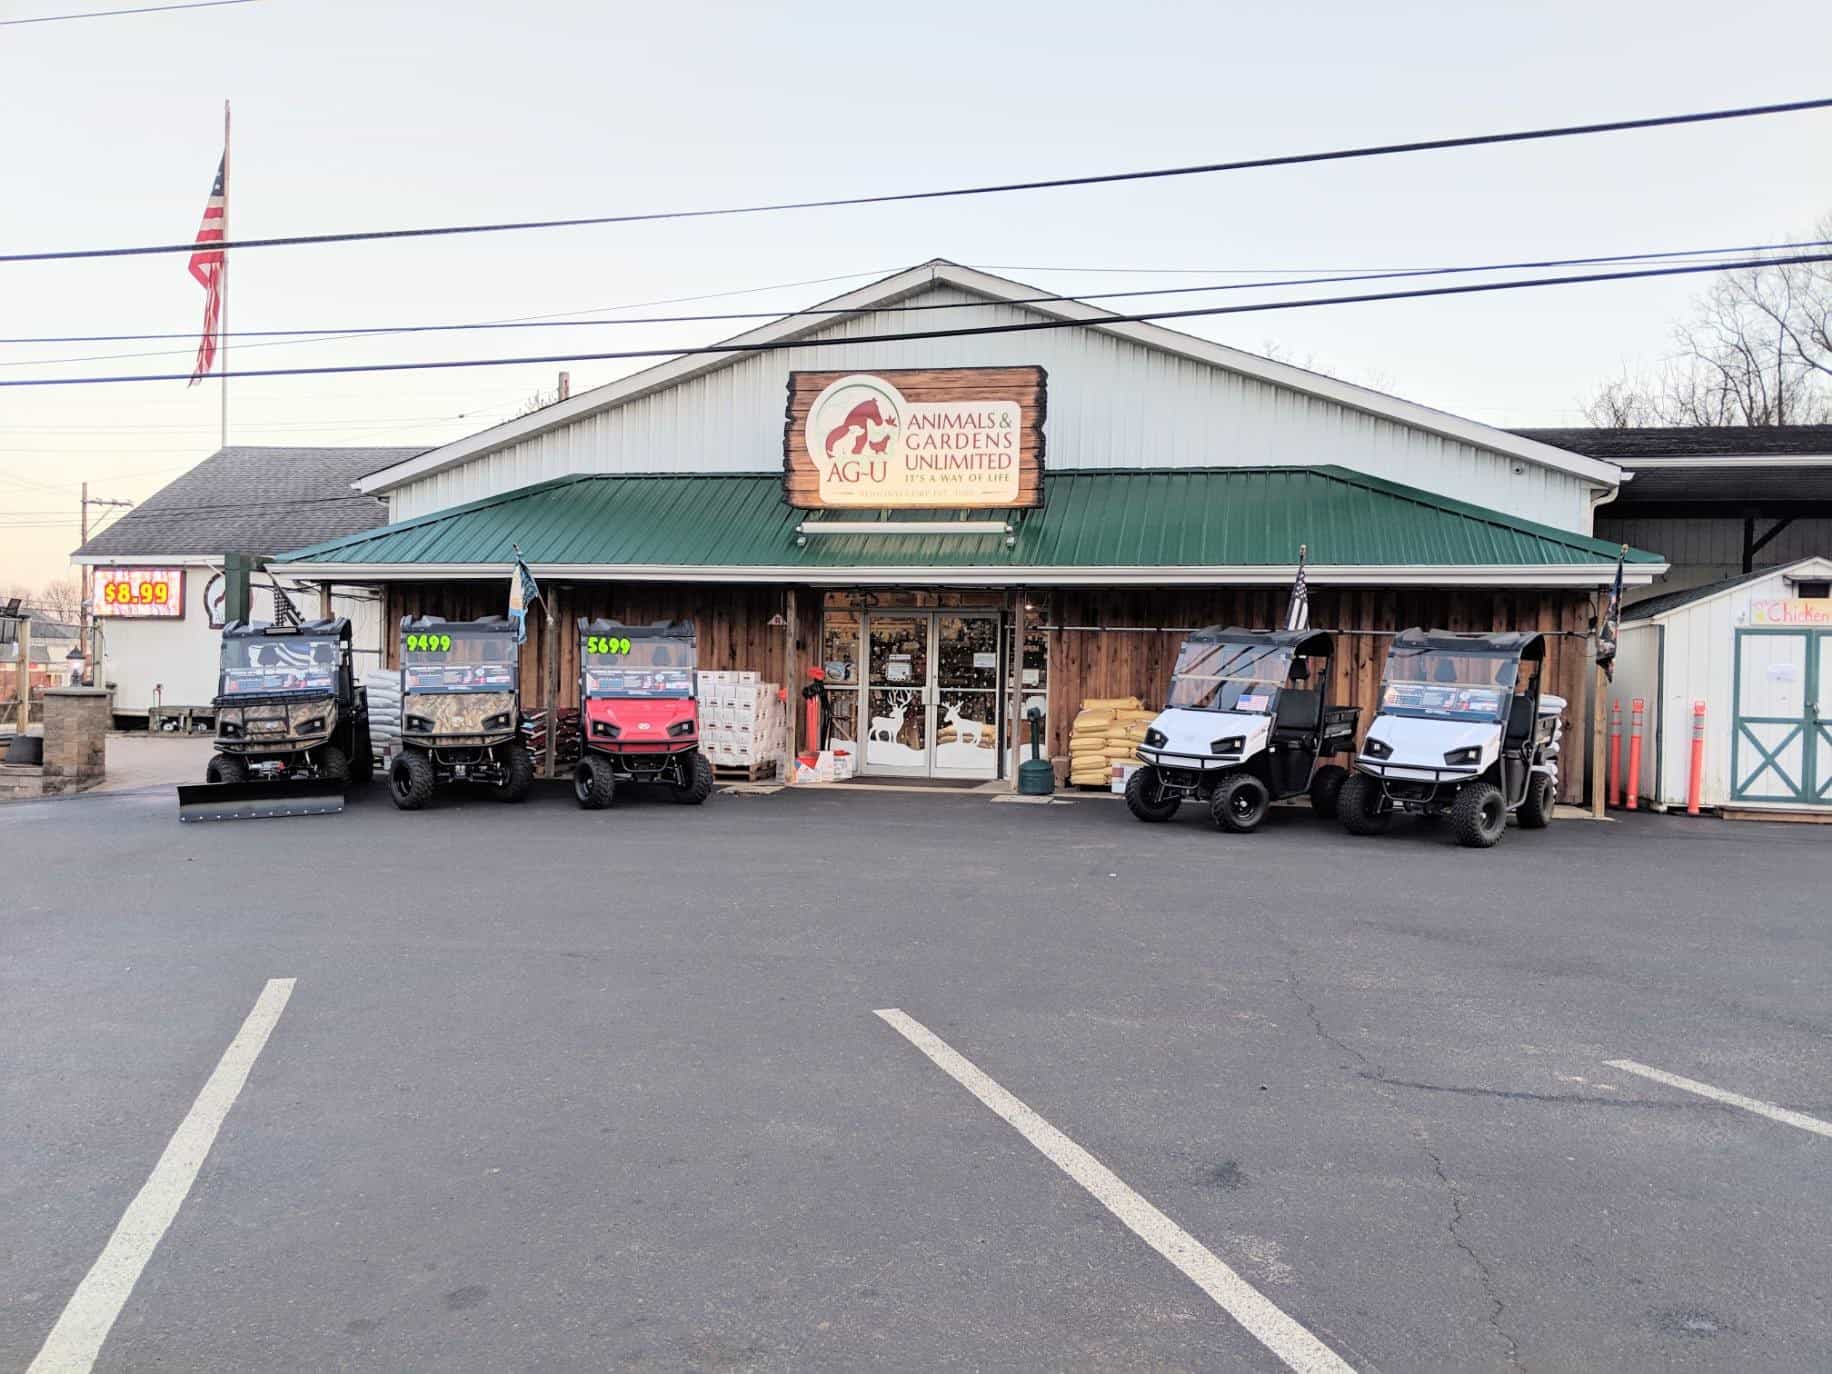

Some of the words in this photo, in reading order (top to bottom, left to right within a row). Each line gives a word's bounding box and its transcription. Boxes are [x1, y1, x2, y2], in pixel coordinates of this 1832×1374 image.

[907, 413, 996, 430] ANIMALS
[1000, 412, 1012, 429] &
[905, 432, 1012, 450] GARDENS
[905, 453, 1012, 471] UNLIMITED
[905, 474, 926, 482] IT'S
[929, 474, 936, 482] A
[941, 473, 963, 482] WAY
[968, 473, 983, 482] OF
[988, 473, 1009, 482] LIFE
[104, 582, 168, 604] $8.99
[406, 633, 452, 653] 9499
[586, 635, 632, 656] 5699
